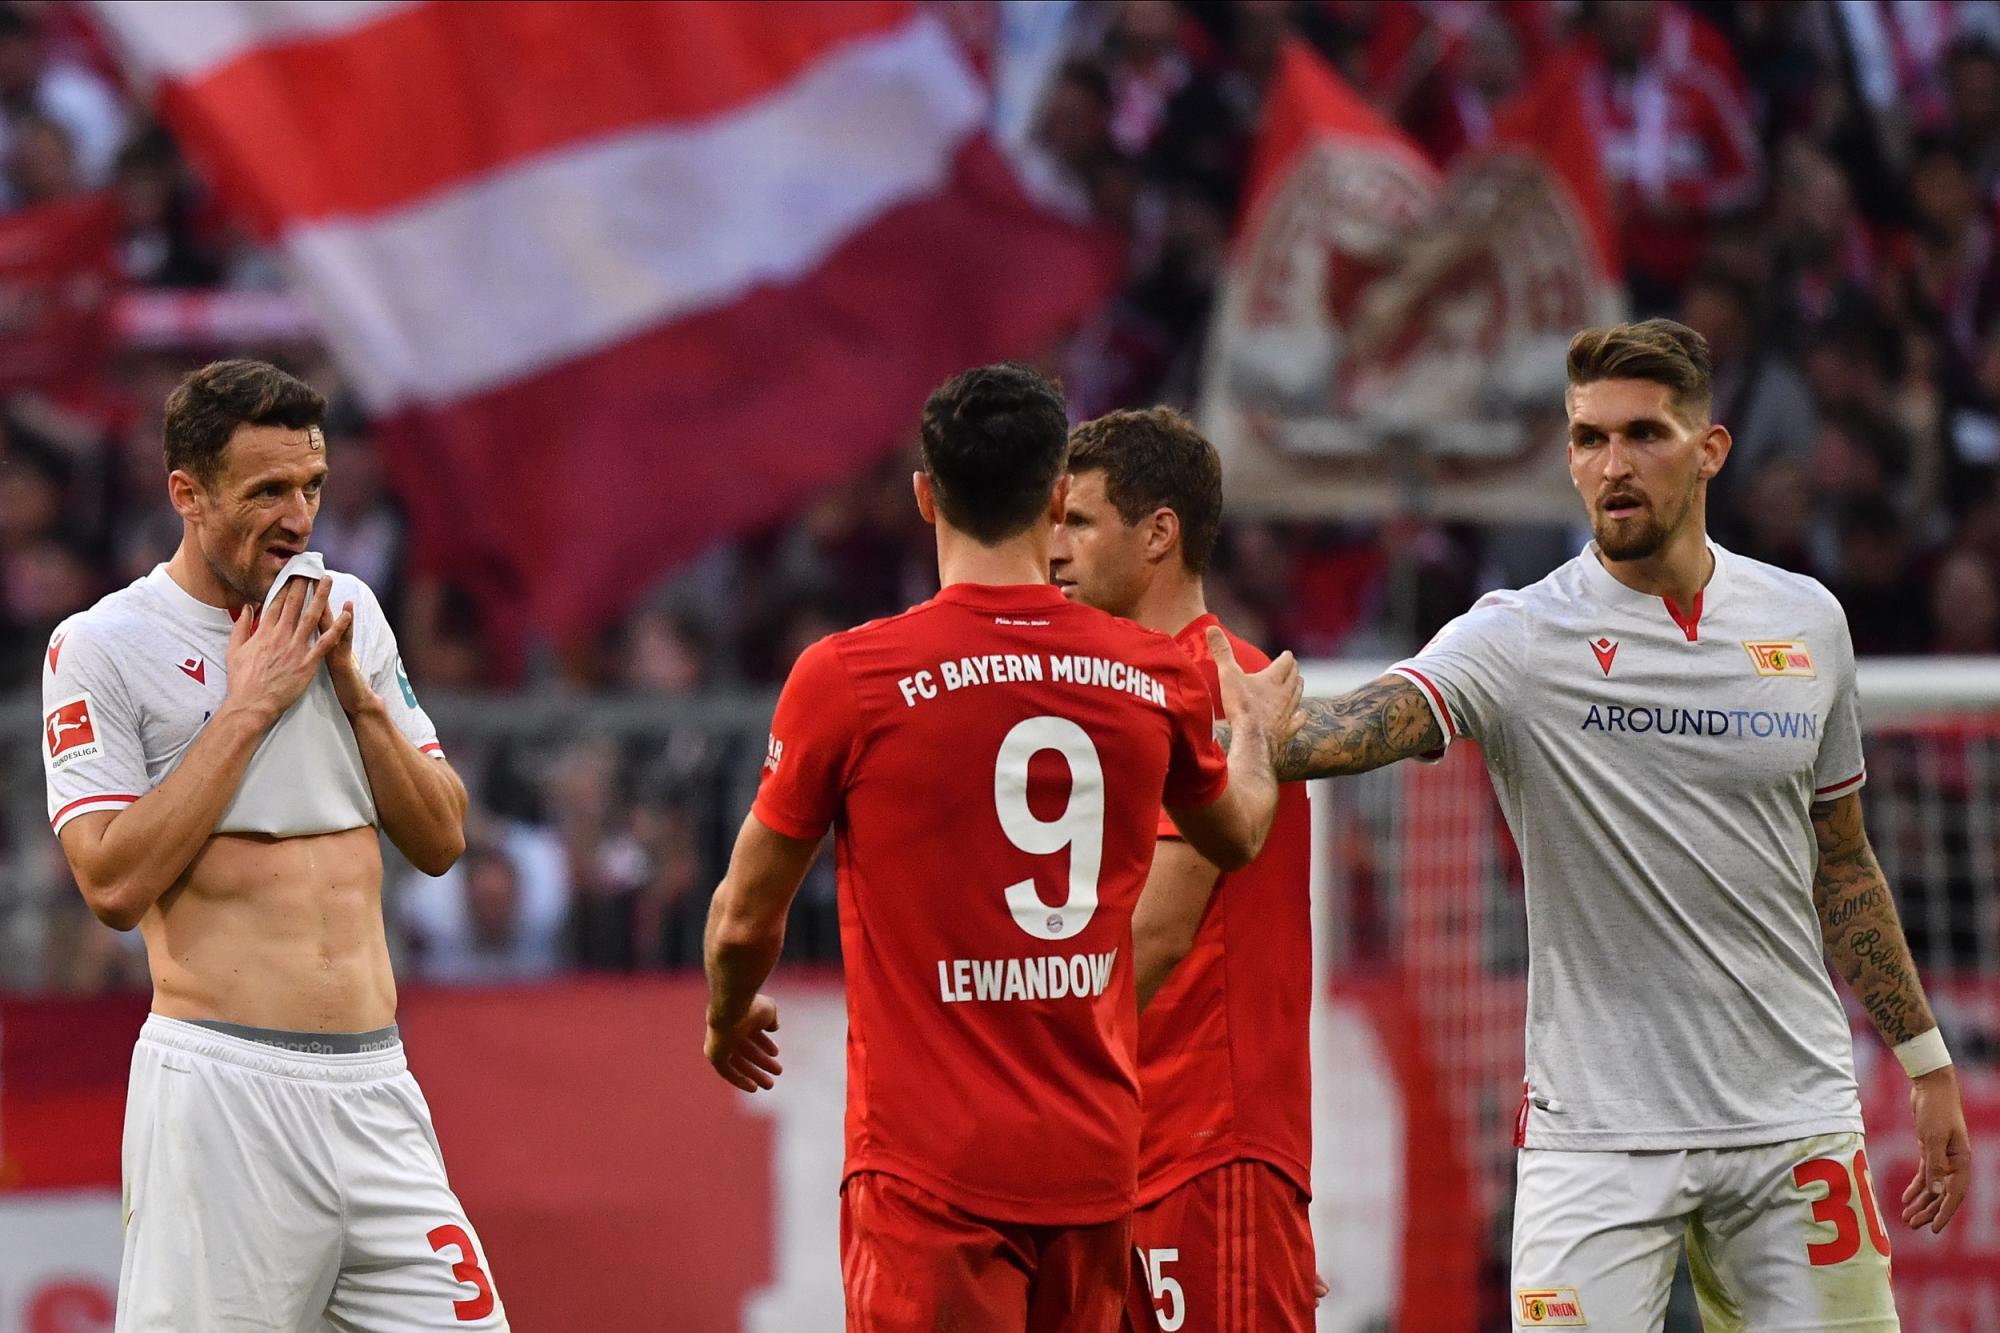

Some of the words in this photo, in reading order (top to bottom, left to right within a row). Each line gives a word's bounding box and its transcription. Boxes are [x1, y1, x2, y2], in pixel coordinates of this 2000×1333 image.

[898, 670, 938, 708] FC
[940, 654, 1044, 692] BAYERN
[1049, 655, 1168, 708] MÜNCHEN
[1581, 704, 1818, 739] AROUNDTOWN
[52, 746, 98, 769] BUNDESLIGA
[994, 715, 1105, 941] 9
[426, 1224, 495, 1321] 3
[1135, 1246, 1186, 1332] 5
[1546, 1302, 1577, 1318] UNION
